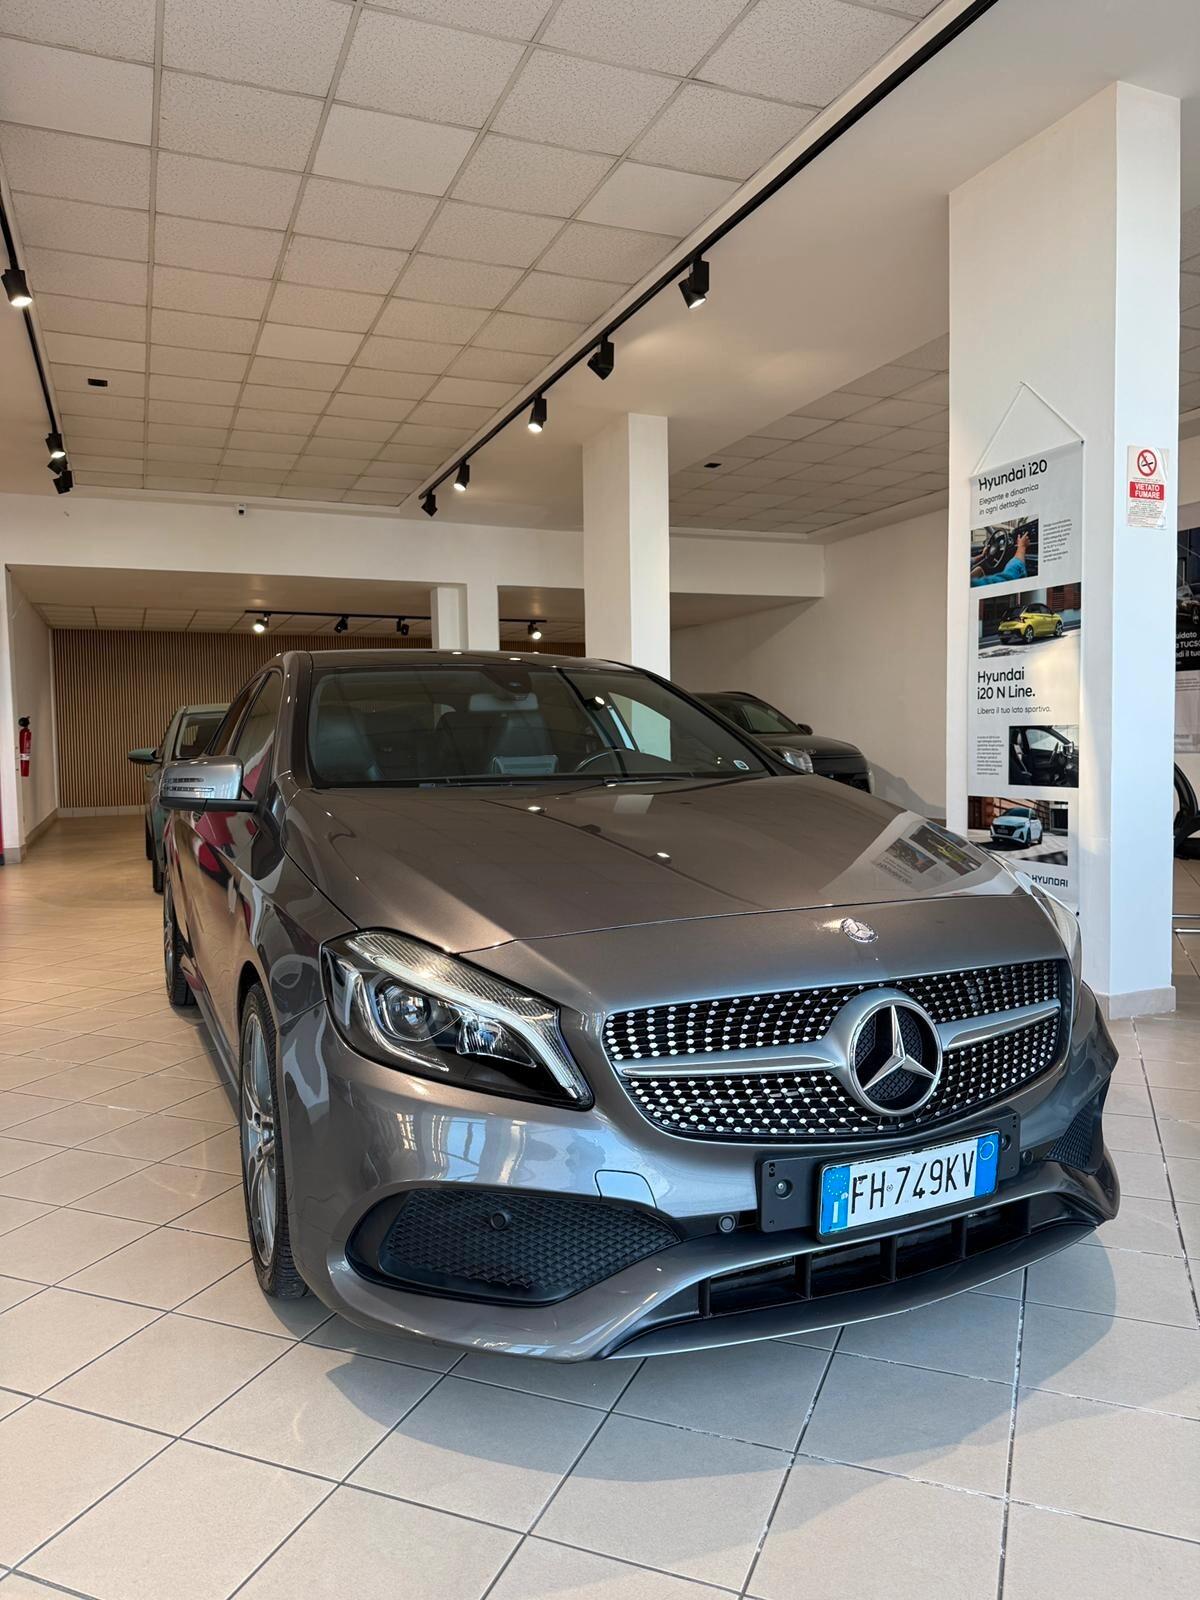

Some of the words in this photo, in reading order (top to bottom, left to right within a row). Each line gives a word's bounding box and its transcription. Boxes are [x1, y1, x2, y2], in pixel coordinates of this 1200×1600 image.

[978, 464, 1026, 491] Hyundai
[1028, 459, 1048, 477] i20
[979, 493, 1004, 506] Elegante
[1010, 483, 1039, 497] dinamica
[1135, 483, 1160, 492] VIETATO
[1135, 490, 1161, 500] FUMARE
[985, 504, 998, 515] ogni
[999, 497, 1027, 510] dettaglio.
[1176, 632, 1197, 640] uidato
[977, 666, 1025, 686] Hyundai
[977, 686, 994, 700] i20
[996, 686, 1006, 699] N
[1008, 684, 1036, 698] Line.
[977, 707, 995, 715] Libera
[1011, 706, 1023, 714] lato
[1024, 705, 1052, 714] sportivo.
[1031, 874, 1069, 888] HYUNDAI
